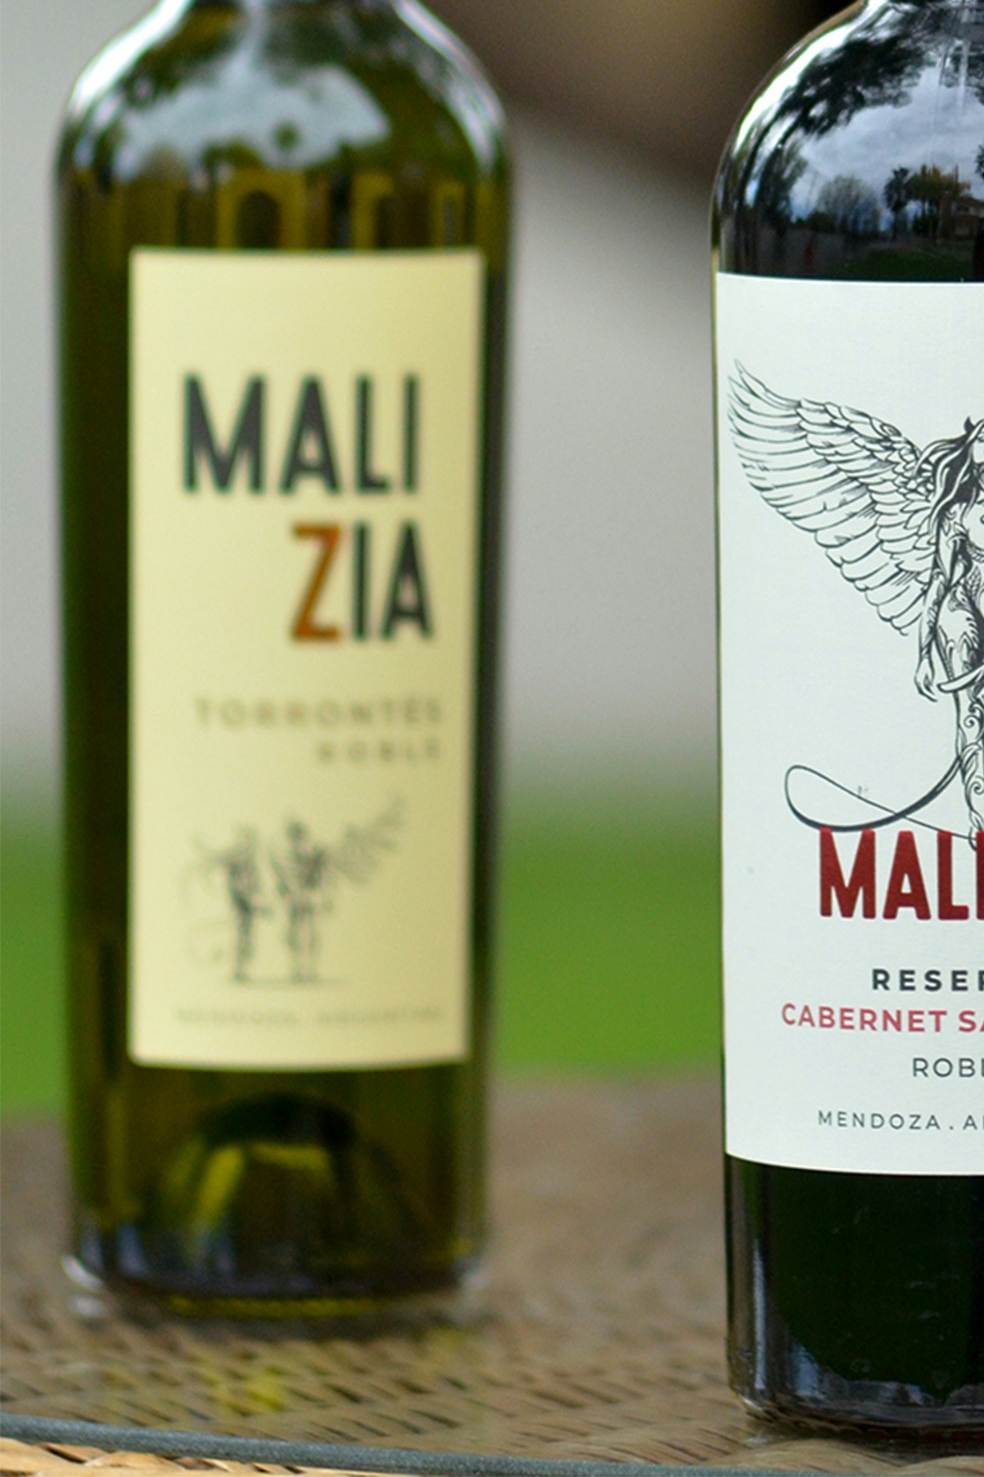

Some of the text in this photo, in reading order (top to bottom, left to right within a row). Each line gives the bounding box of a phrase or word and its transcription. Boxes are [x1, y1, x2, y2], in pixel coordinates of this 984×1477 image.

[182, 374, 419, 496] MALI
[291, 521, 433, 642] ZIA
[781, 1002, 947, 1032] CABERNET
[818, 1110, 940, 1130] MENDOZA
